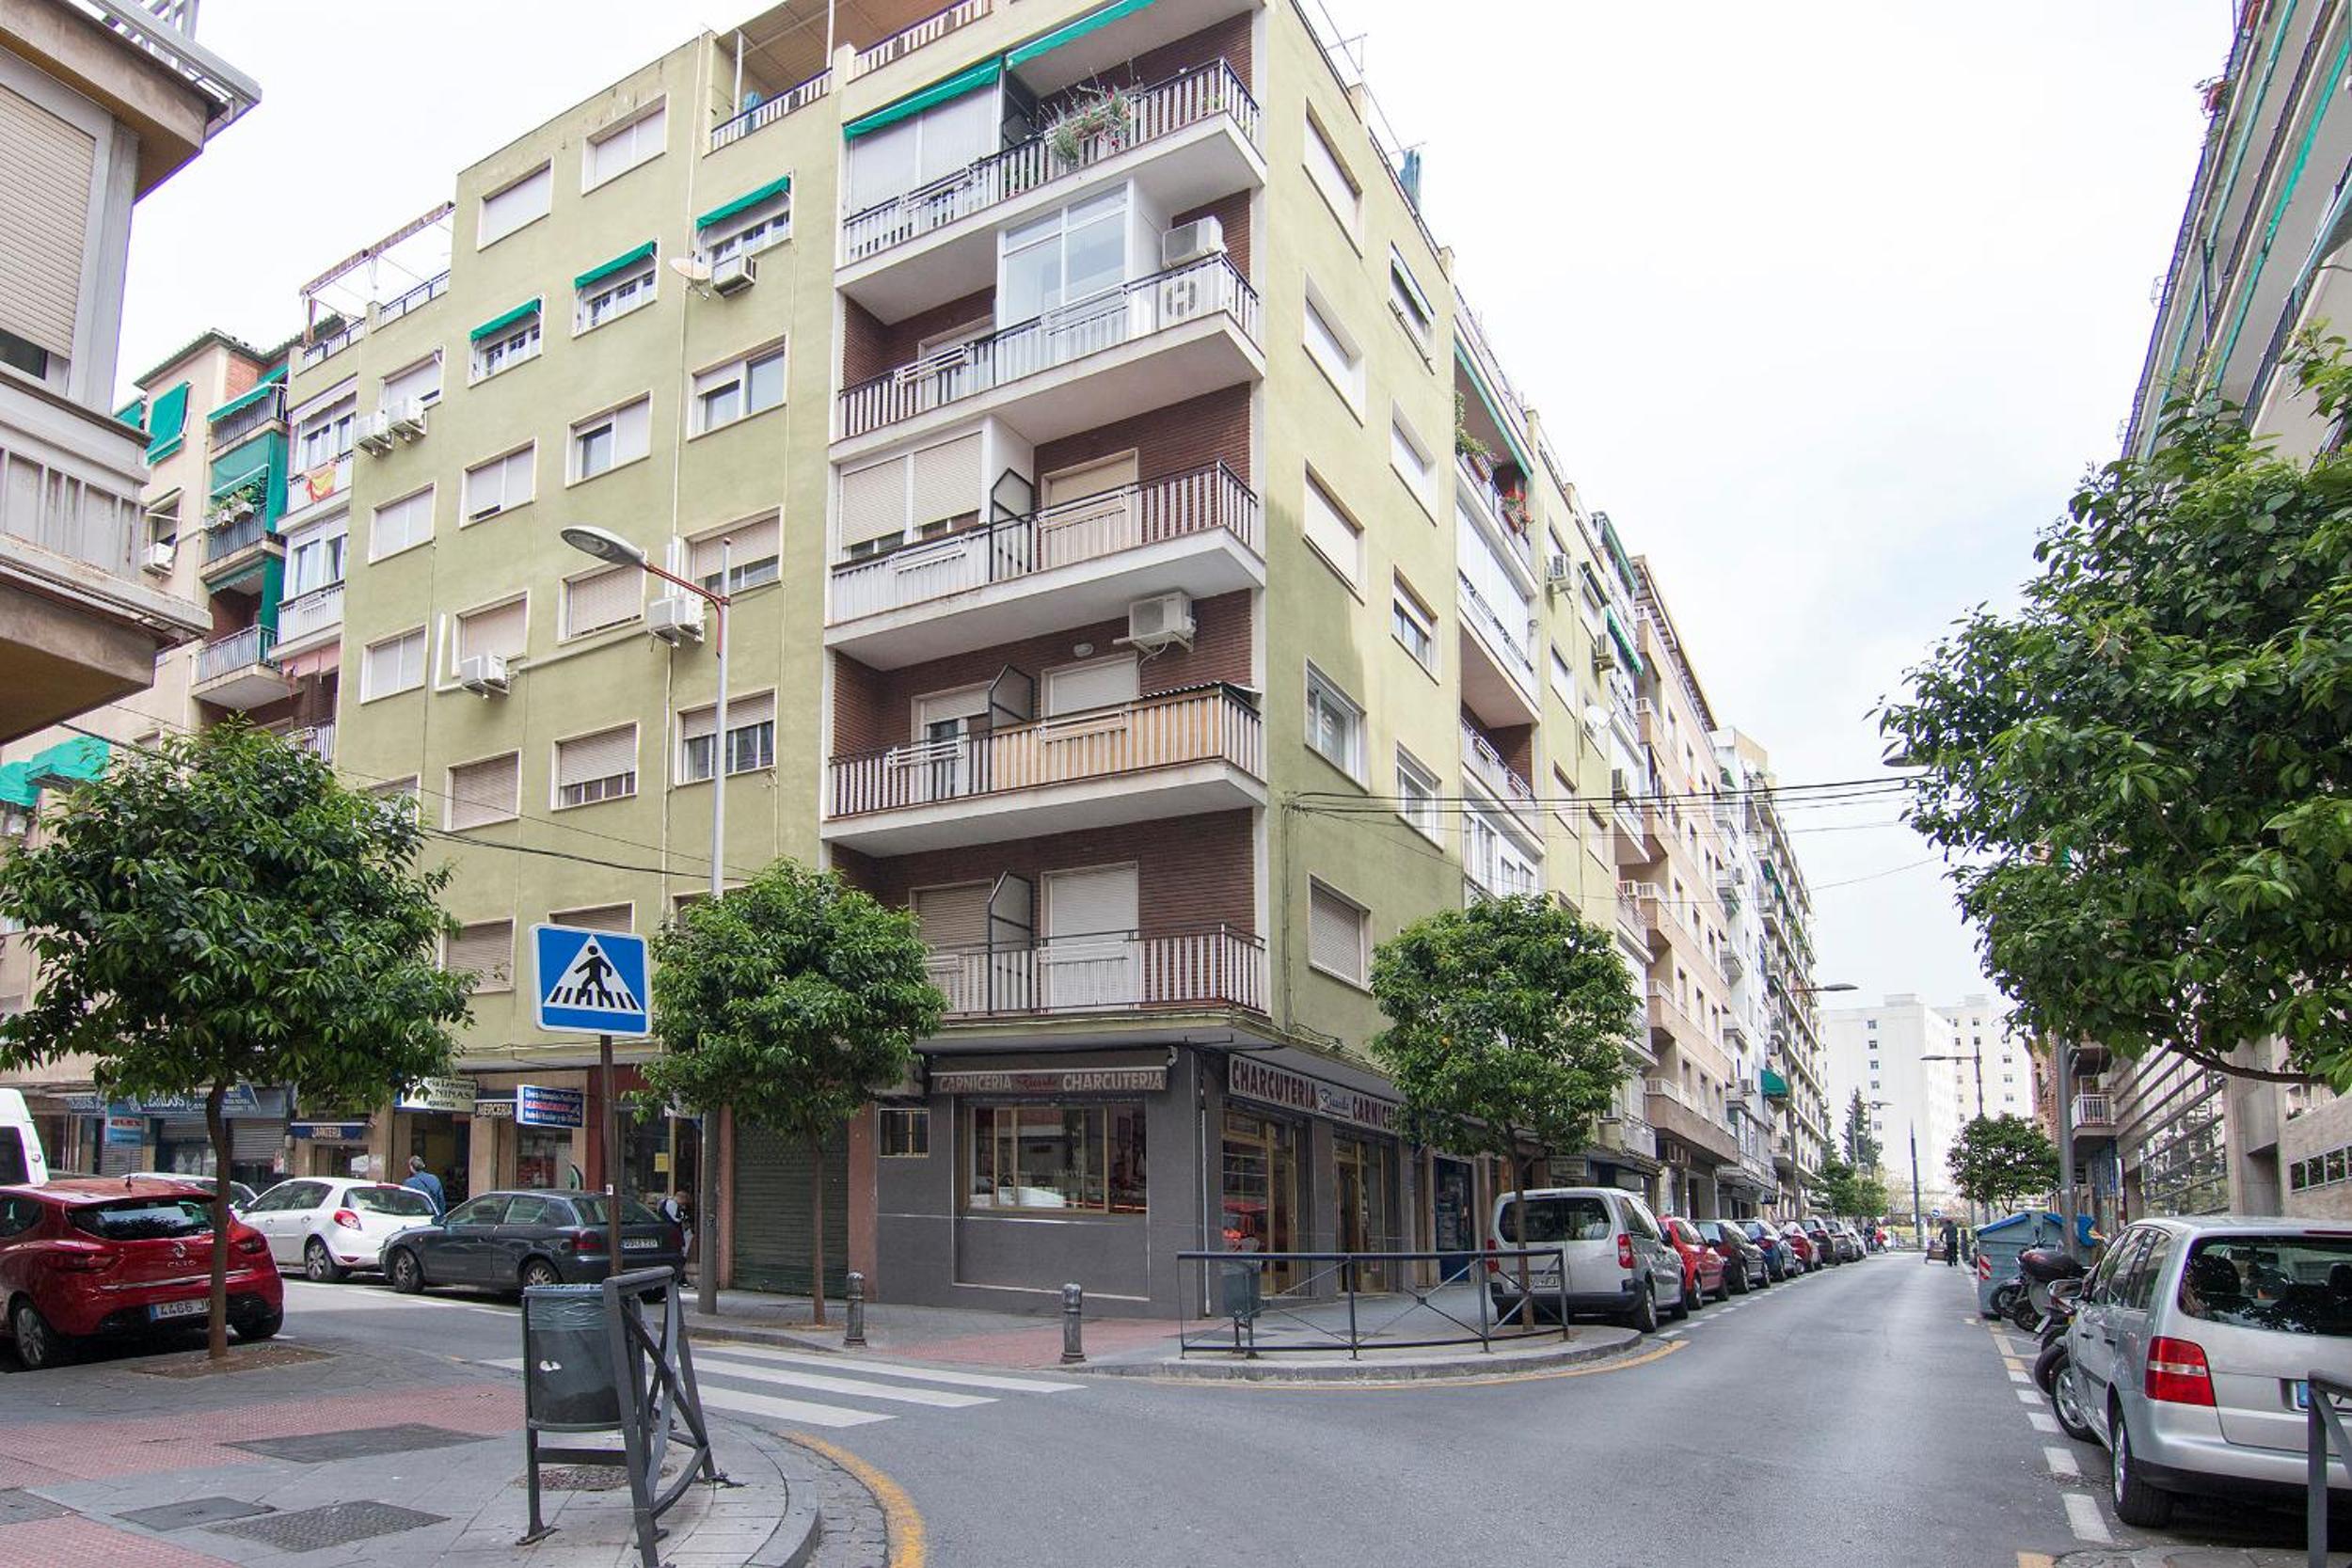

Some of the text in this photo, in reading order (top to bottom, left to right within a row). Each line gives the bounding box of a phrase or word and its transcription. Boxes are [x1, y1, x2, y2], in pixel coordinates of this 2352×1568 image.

[940, 1073, 1012, 1092] CARNICERIA
[1062, 1071, 1163, 1092] CHARCUTERIA
[1232, 1060, 1317, 1109] CHARCUTERIA
[1353, 1096, 1395, 1130] CARNICE
